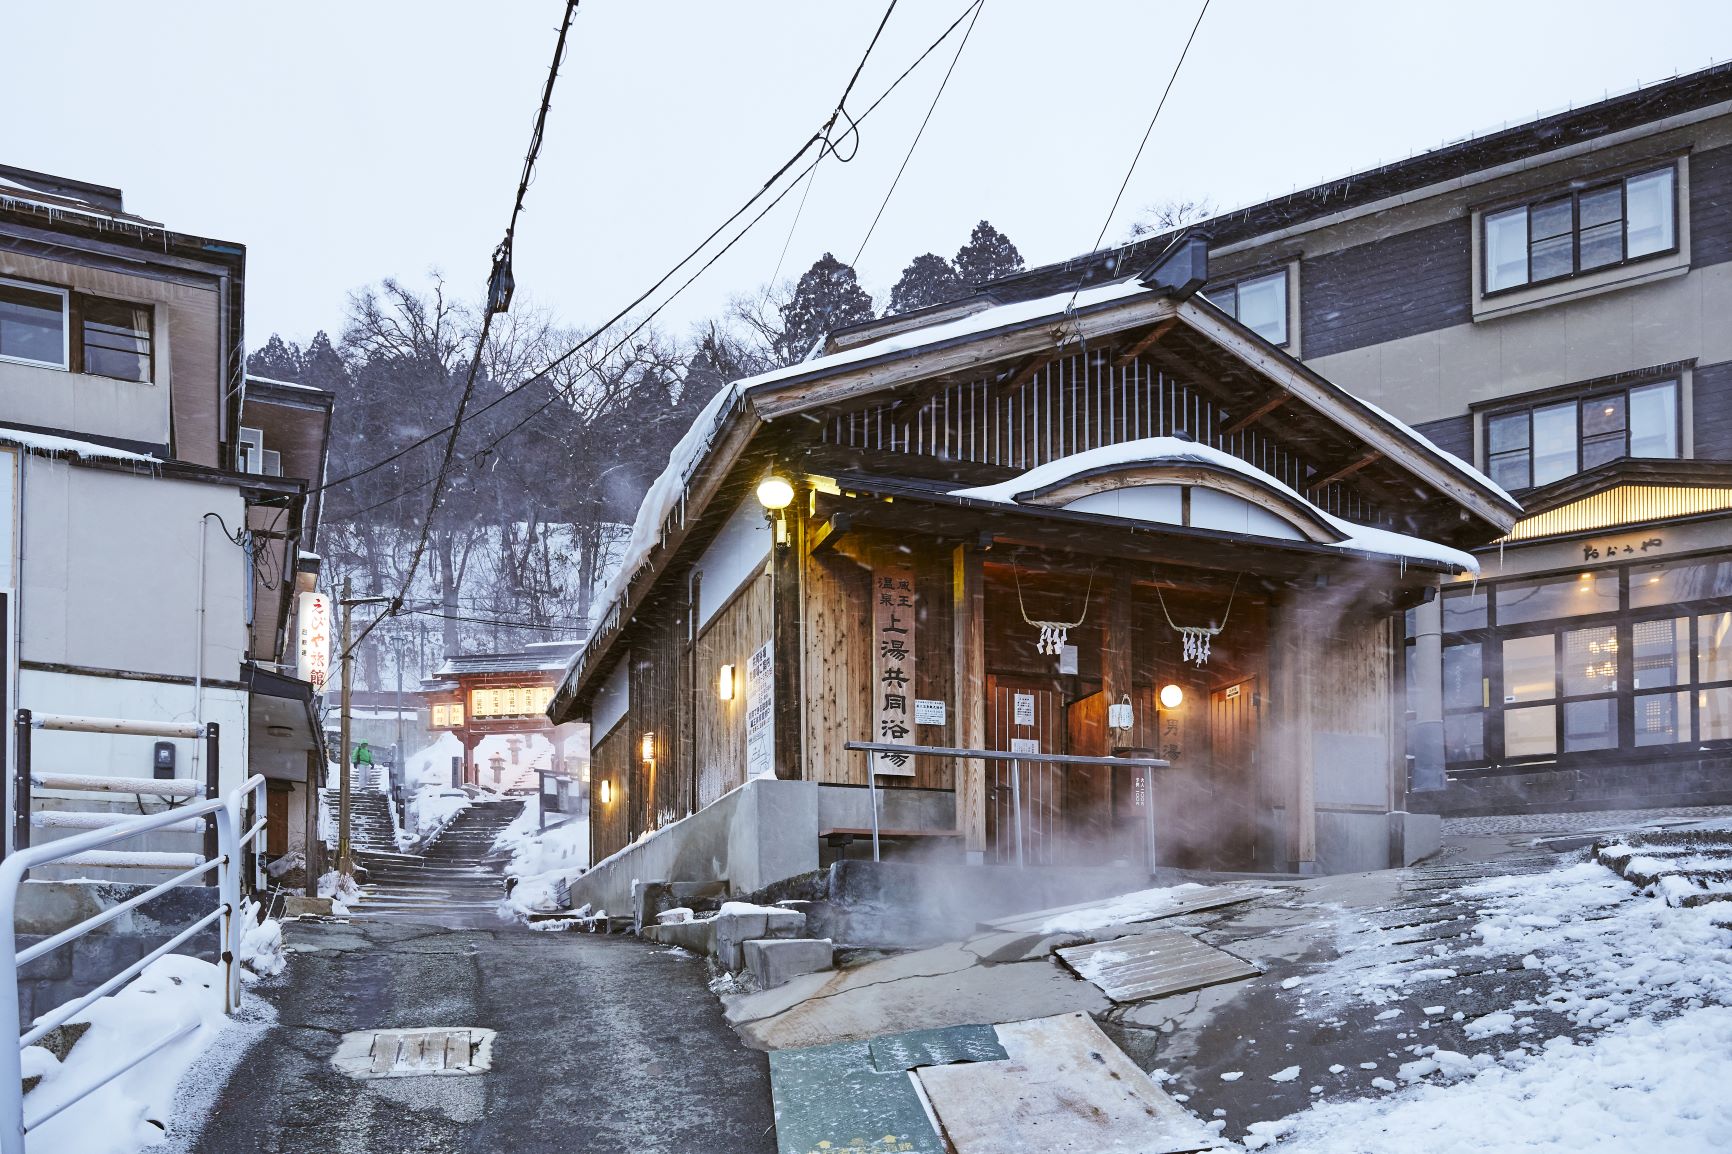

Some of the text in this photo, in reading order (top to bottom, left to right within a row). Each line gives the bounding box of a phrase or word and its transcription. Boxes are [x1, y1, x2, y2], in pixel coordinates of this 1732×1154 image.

[878, 576, 895, 607] 温泉
[310, 598, 325, 686] えびや旅館
[880, 613, 910, 768] 上湯共同浴場
[1163, 718, 1181, 760] 男湯
